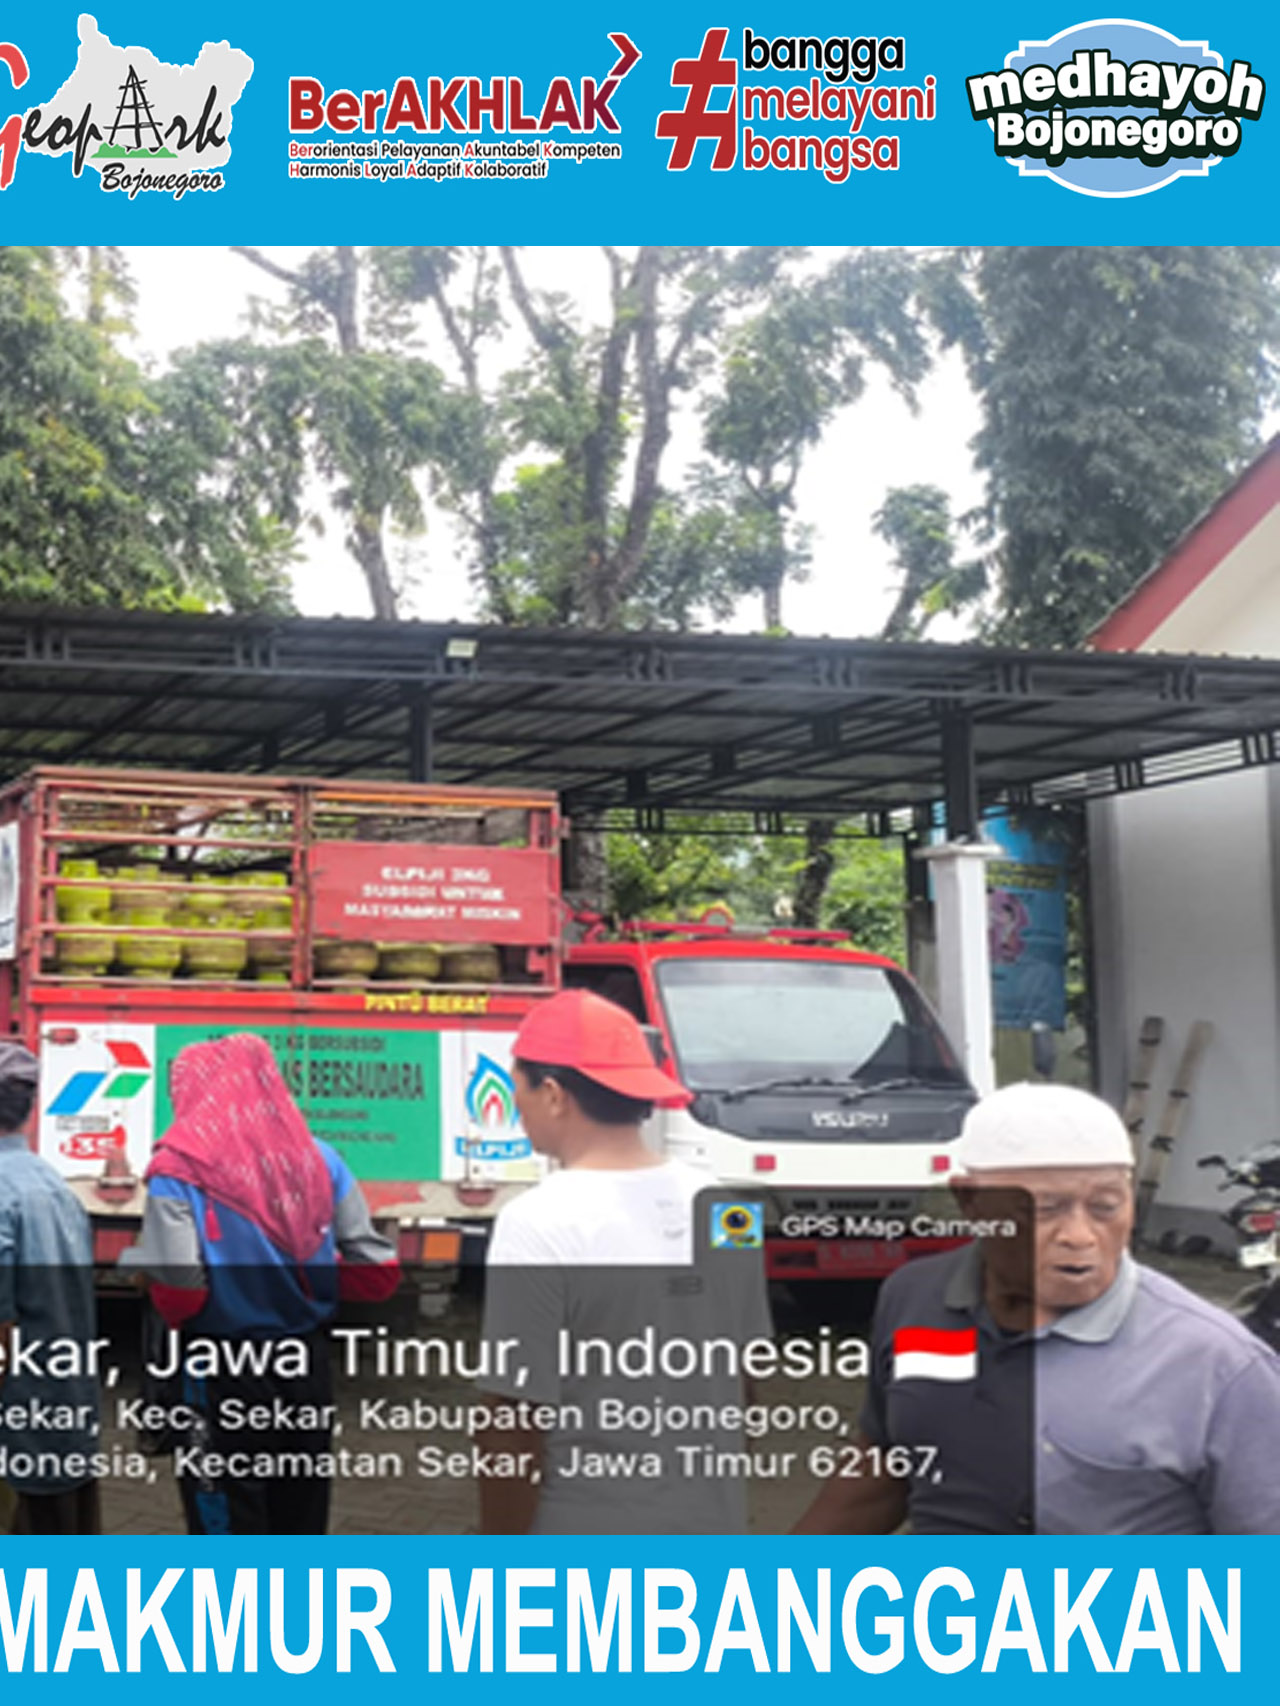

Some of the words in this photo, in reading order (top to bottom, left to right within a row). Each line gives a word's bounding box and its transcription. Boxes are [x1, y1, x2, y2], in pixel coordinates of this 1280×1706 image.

[361, 883, 437, 899] SUBSIDI
[441, 885, 504, 901] UNTUK
[343, 902, 457, 919] MASYARAKAT
[461, 906, 522, 921] MISKIN
[309, 1059, 426, 1100] BERSAUDARA
